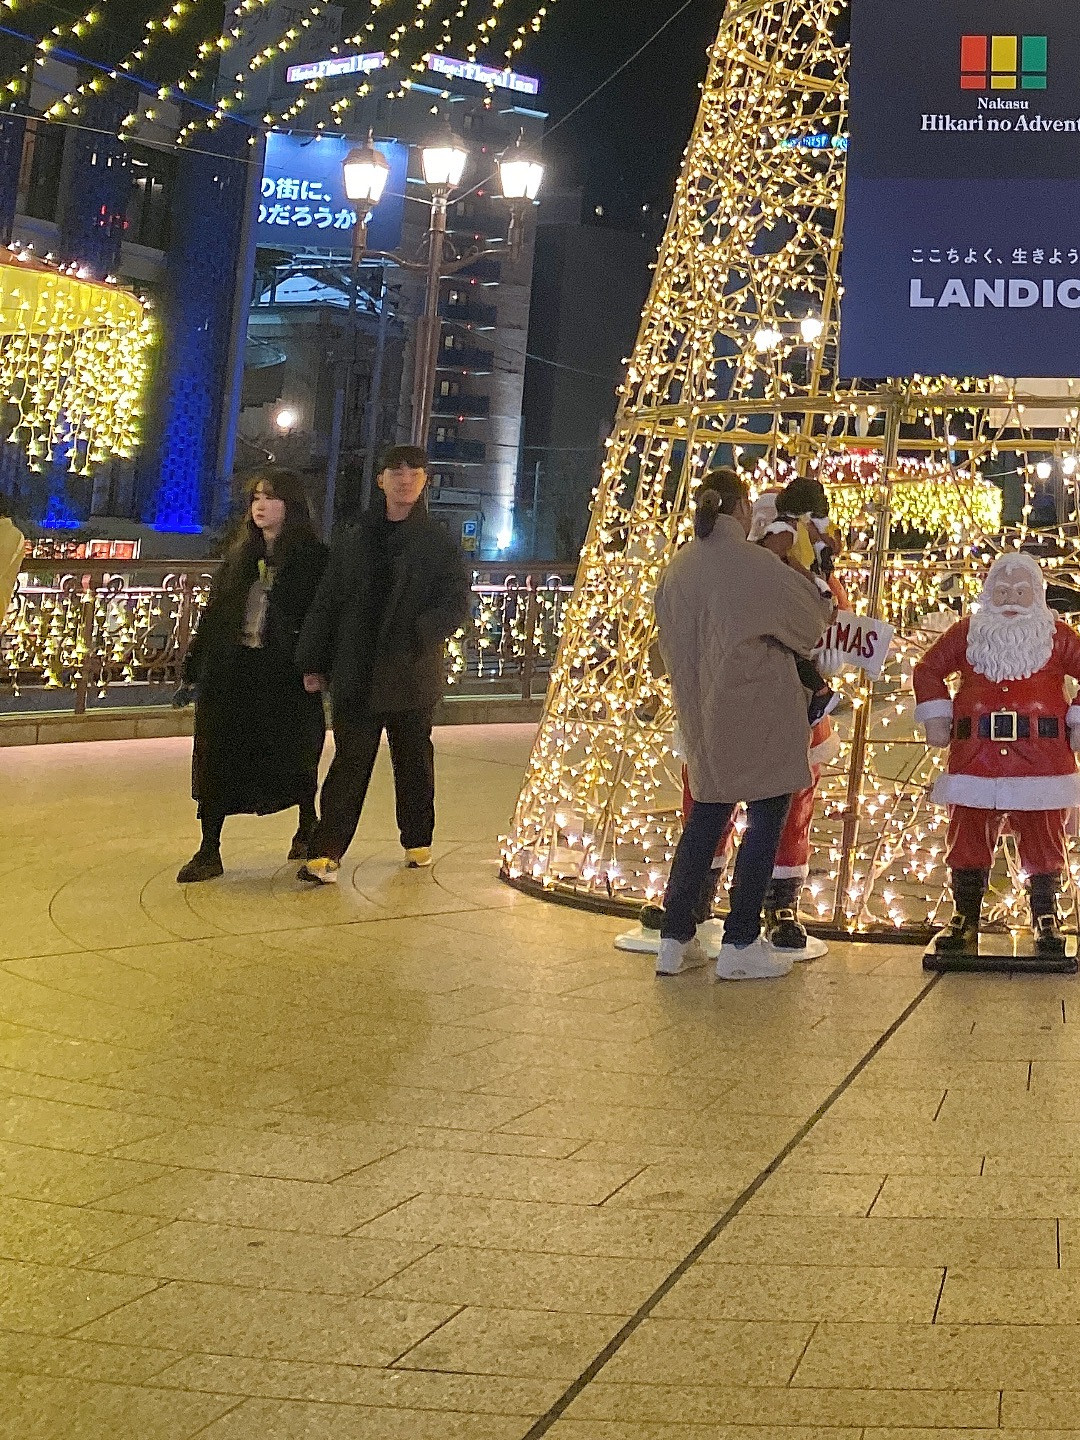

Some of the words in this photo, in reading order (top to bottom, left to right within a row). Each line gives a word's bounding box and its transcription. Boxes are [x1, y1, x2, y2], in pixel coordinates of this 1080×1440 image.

[433, 58, 464, 79] Hotel
[464, 63, 507, 88] Floral
[509, 73, 534, 94] Inn
[977, 97, 1029, 110] Nakasu
[920, 114, 984, 132] Hikari
[986, 119, 1011, 132] no
[465, 524, 475, 533] P
